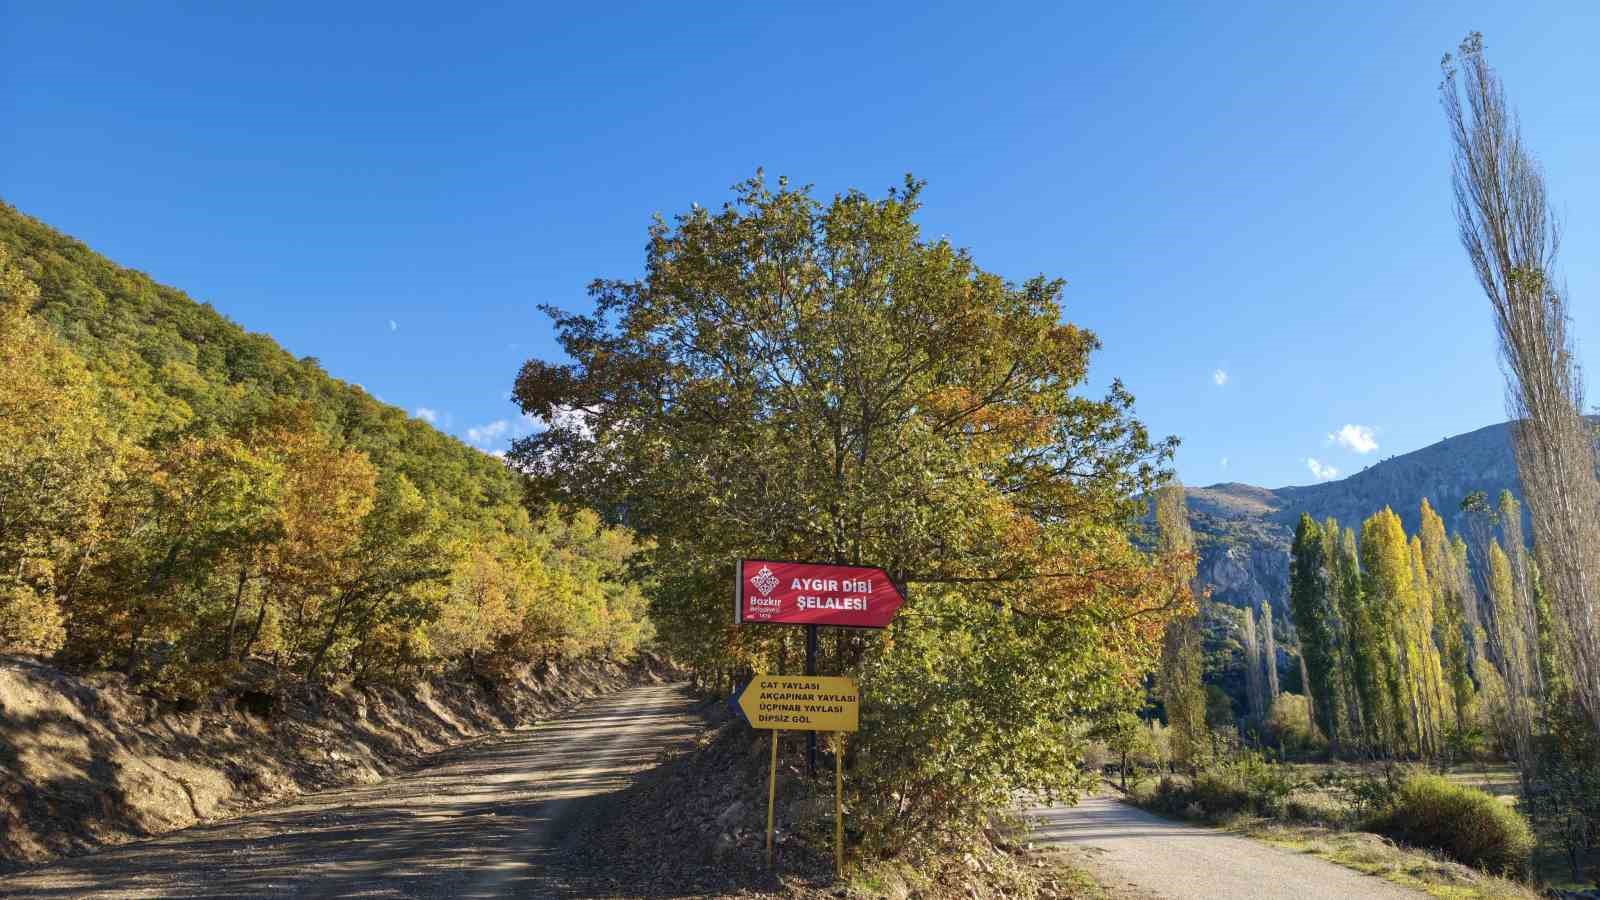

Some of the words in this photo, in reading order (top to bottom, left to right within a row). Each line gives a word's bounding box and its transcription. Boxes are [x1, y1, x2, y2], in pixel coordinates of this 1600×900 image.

[791, 578, 839, 592] AYGIR
[842, 578, 872, 594] DİBİ
[796, 596, 867, 612] ŞELALESİ
[782, 682, 820, 691] YAYLASI
[817, 694, 856, 703] YAYLASI
[804, 705, 843, 713] YAYLASI
